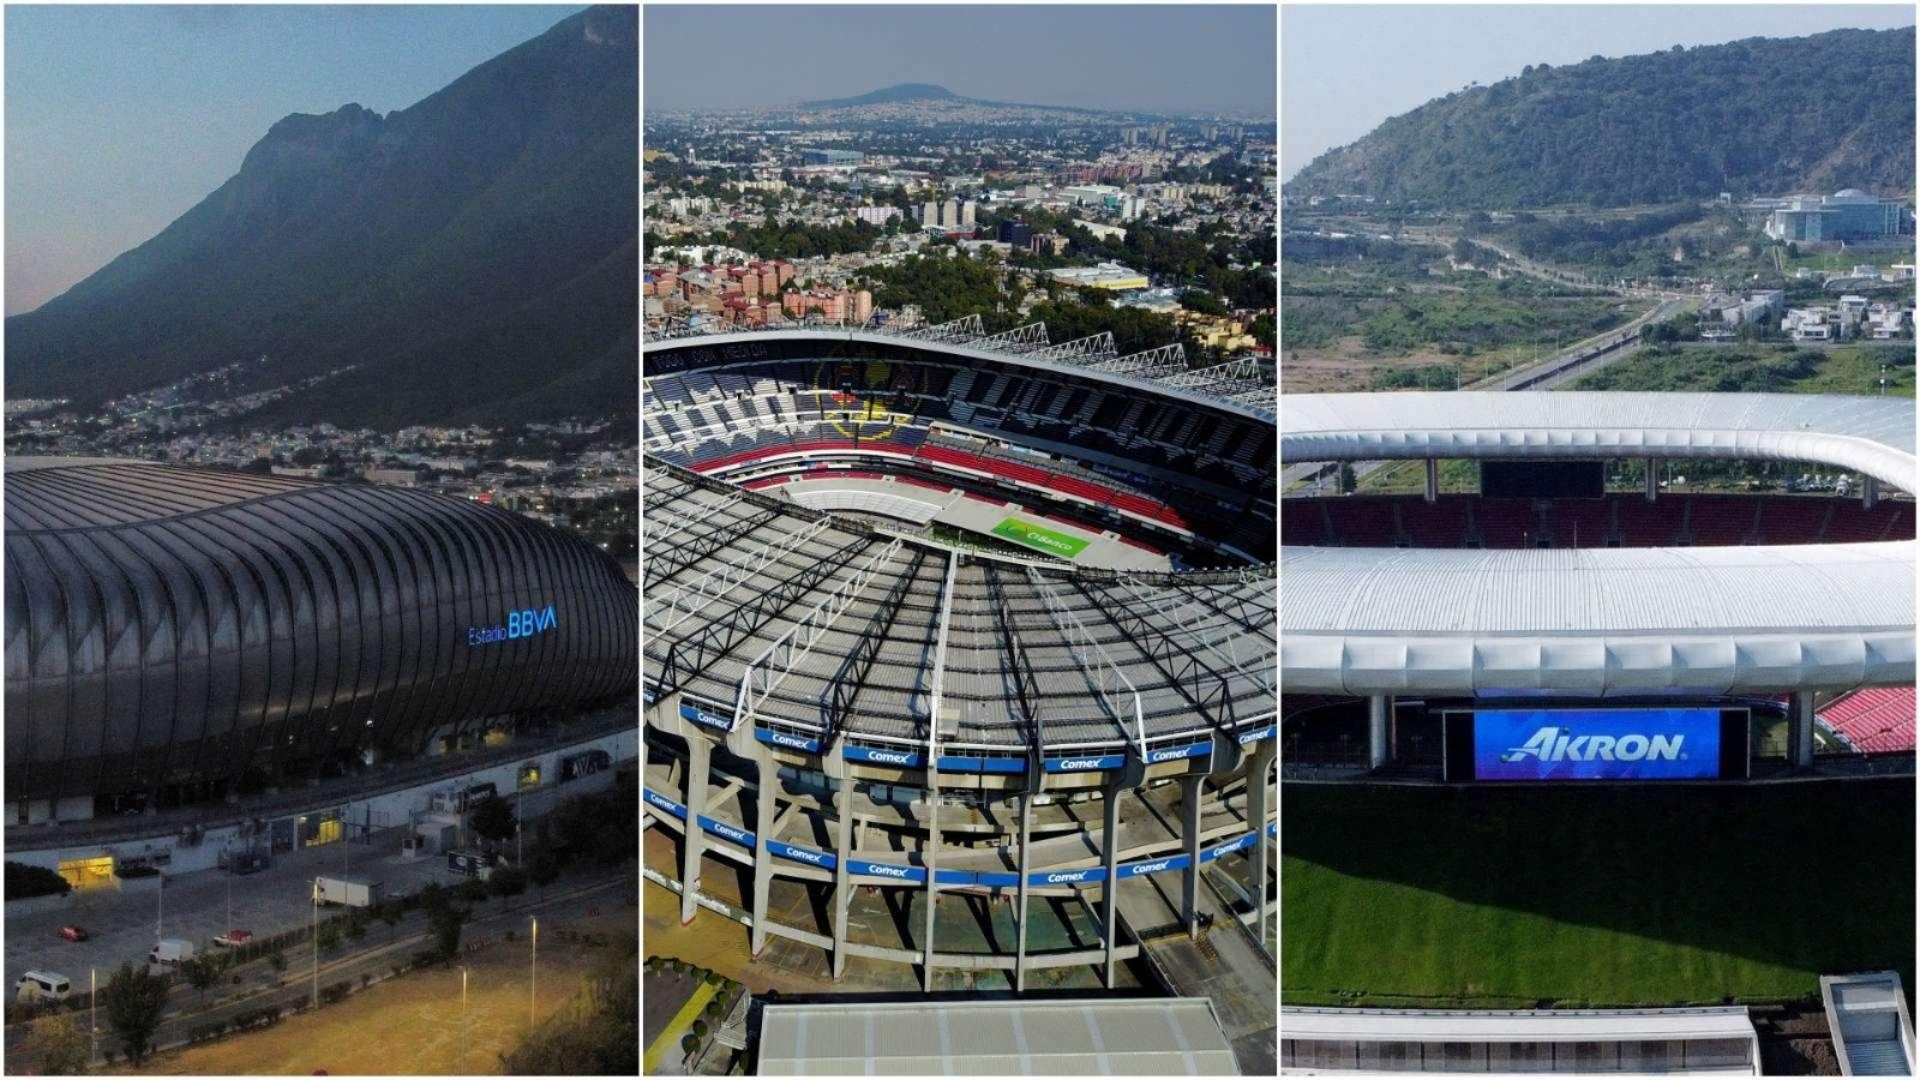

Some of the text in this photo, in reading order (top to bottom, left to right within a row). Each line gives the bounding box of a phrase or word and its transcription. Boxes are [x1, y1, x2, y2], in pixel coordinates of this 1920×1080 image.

[468, 604, 557, 646] Estadio BBVA
[697, 713, 730, 729] Comex
[772, 733, 810, 750] Comex
[1239, 729, 1272, 745] Comex
[1506, 726, 1686, 762] AKRON
[868, 750, 912, 764] Comex
[1152, 747, 1191, 761] Comex
[1060, 758, 1103, 770] Comex
[650, 793, 677, 812] Comex
[714, 822, 745, 841] Comex
[786, 847, 825, 863] Comex
[1213, 839, 1245, 857] Comex
[868, 864, 909, 878] Comex
[1132, 860, 1170, 874] Comex
[1048, 870, 1088, 883] Comex
